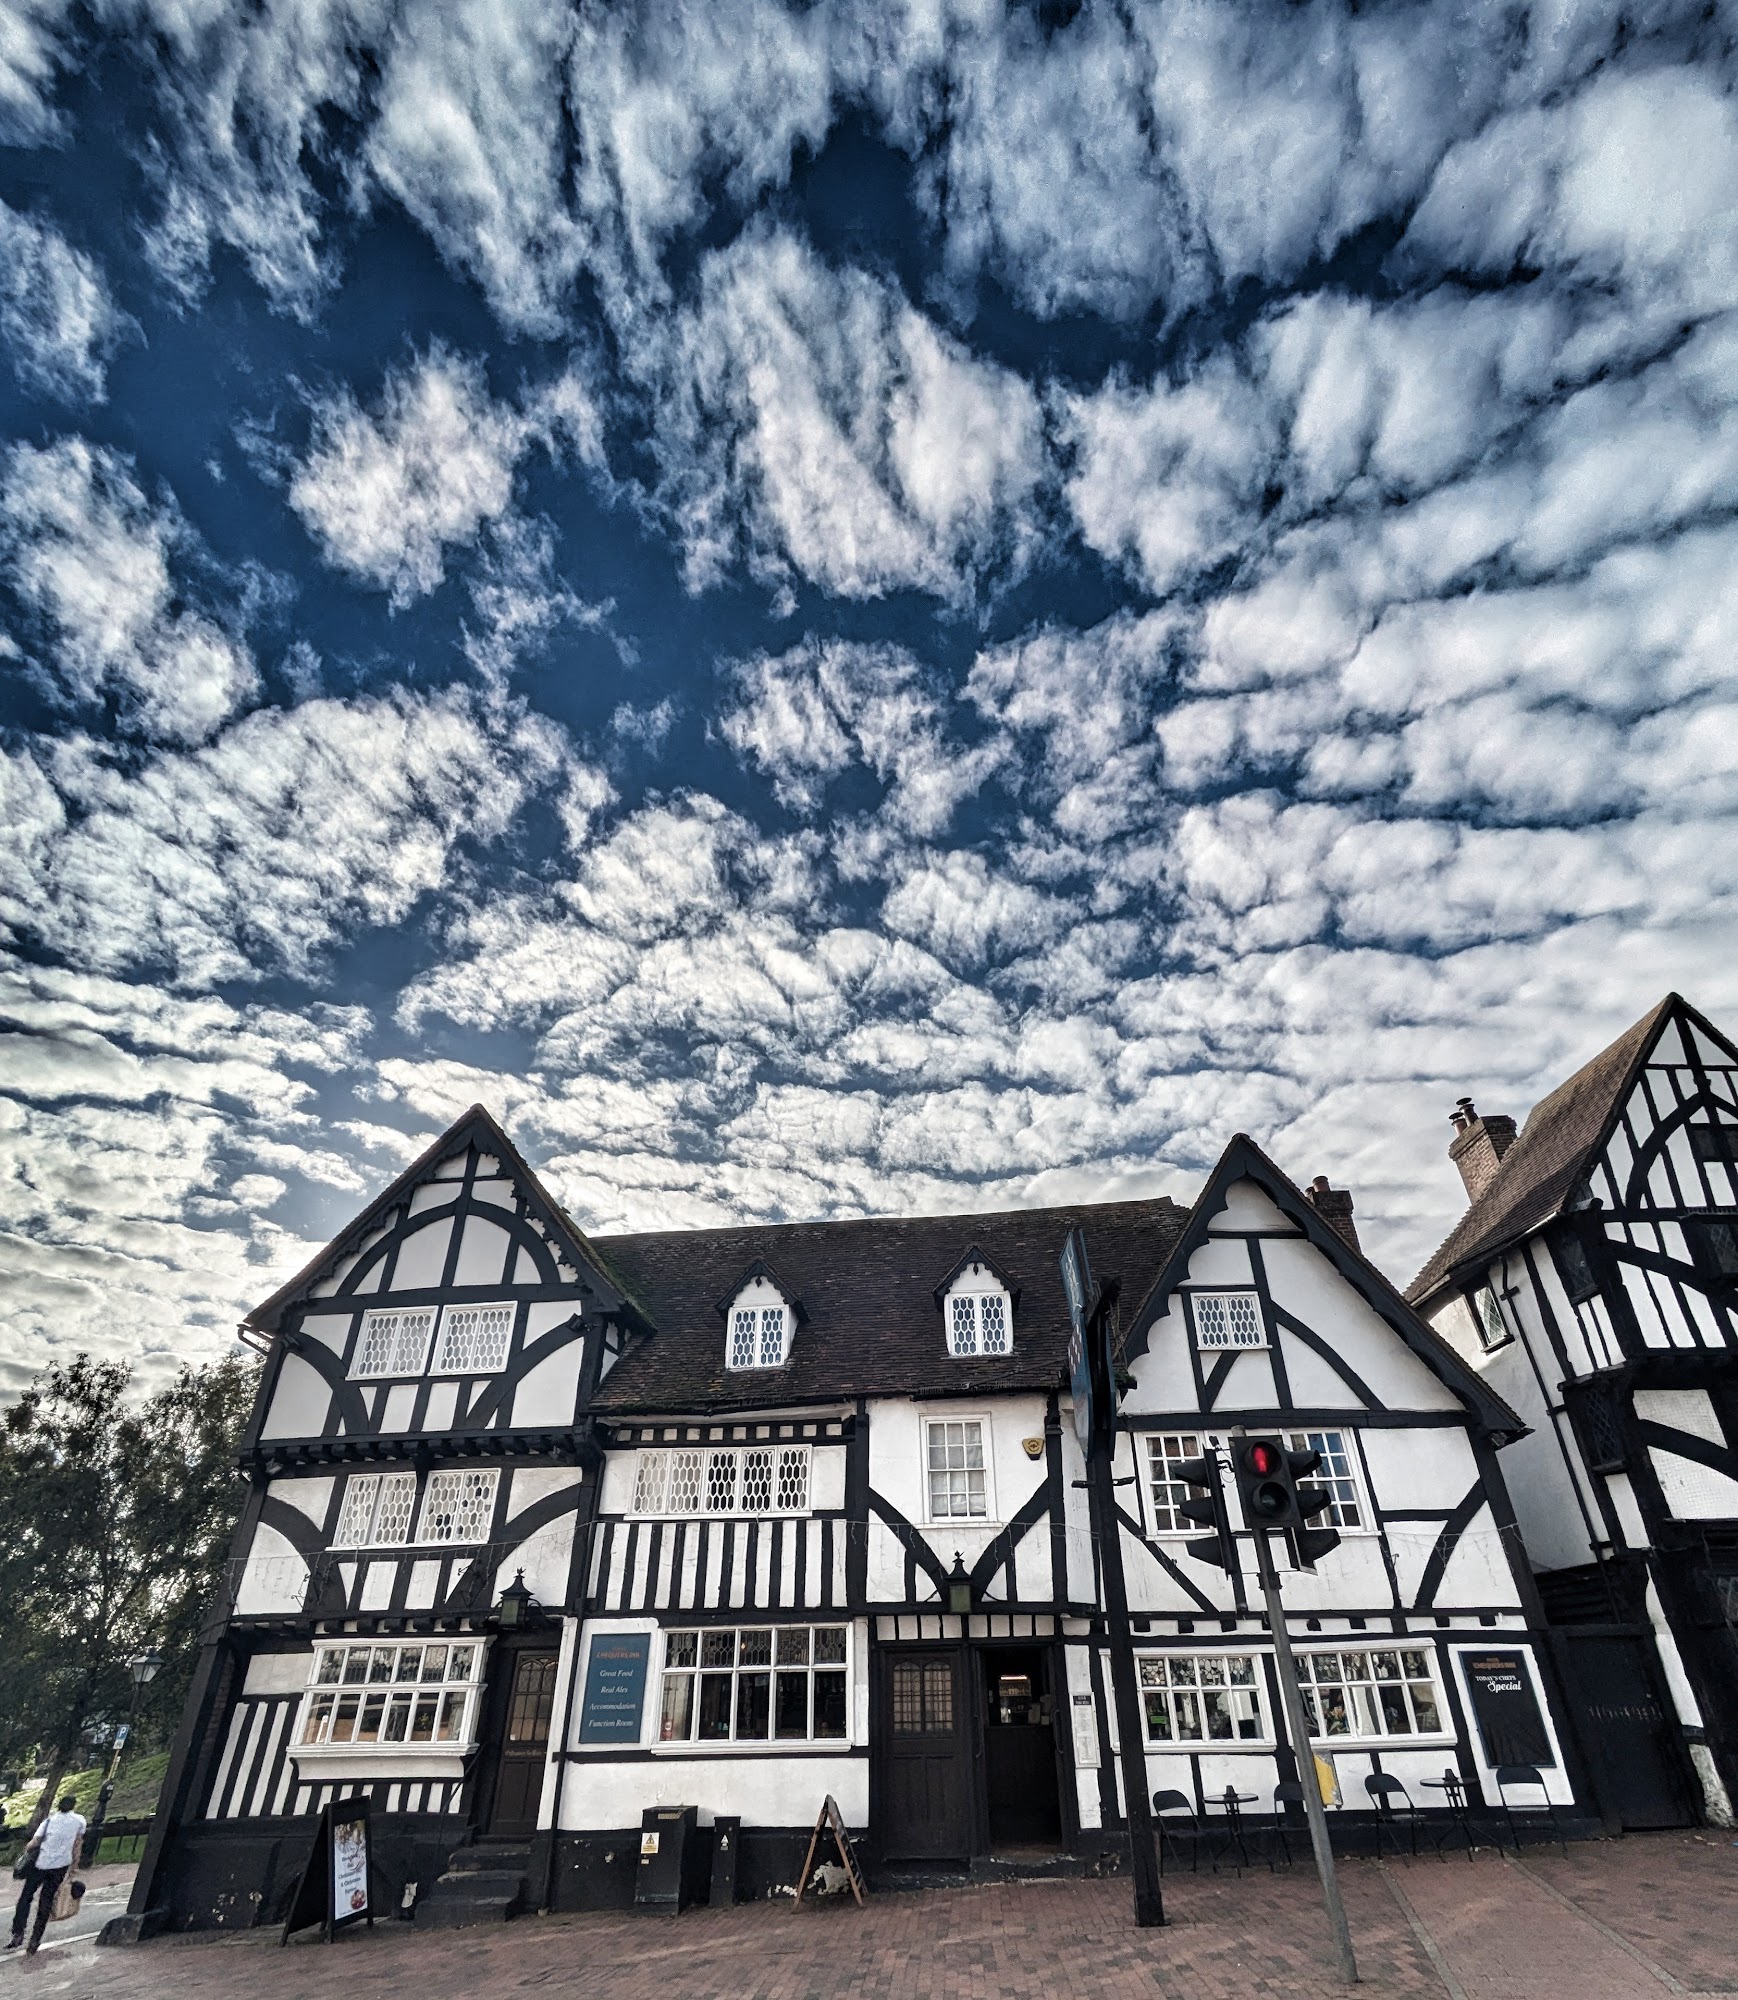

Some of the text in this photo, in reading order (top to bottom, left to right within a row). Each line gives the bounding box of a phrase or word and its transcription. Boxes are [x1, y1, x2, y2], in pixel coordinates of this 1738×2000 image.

[617, 1669, 634, 1677] Food
[600, 1685, 629, 1694] Real Ales
[1487, 1680, 1522, 1694] Special
[589, 1702, 636, 1711] Accommodation
[588, 1719, 634, 1728] Function Room
[119, 1726, 127, 1738] P
